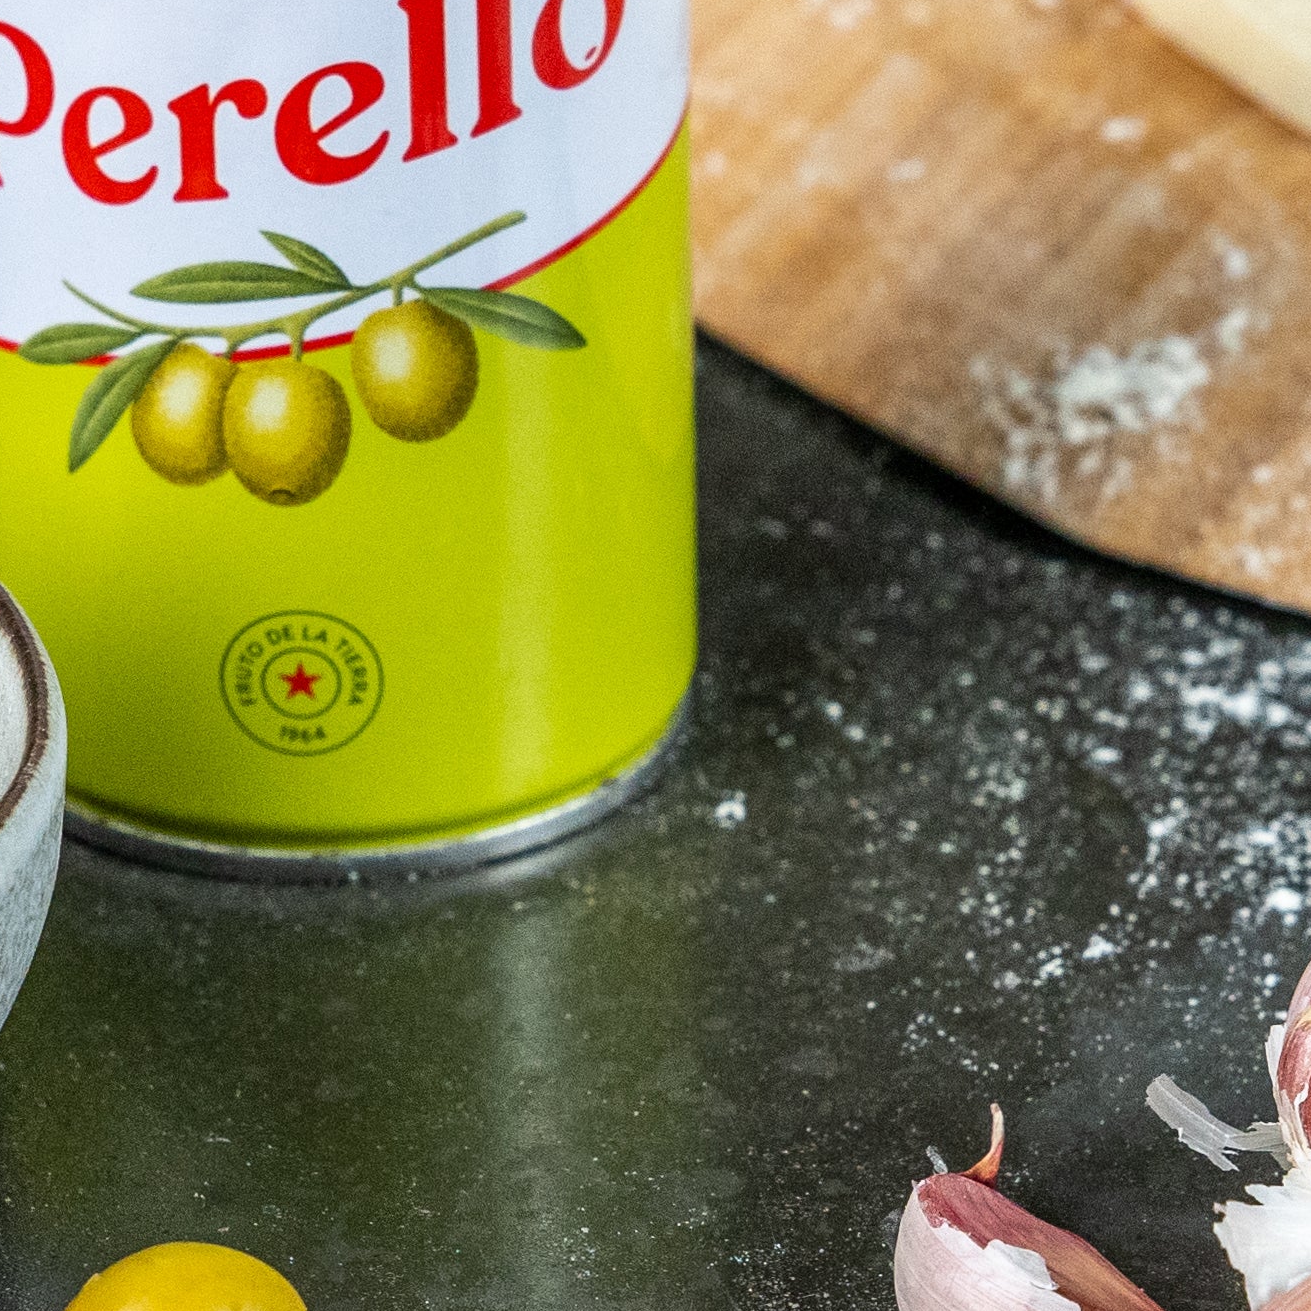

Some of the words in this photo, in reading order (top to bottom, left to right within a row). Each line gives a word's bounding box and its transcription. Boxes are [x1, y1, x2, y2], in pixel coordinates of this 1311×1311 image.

[235, 640, 264, 706] FRUTO
[265, 624, 294, 646] DE
[301, 625, 328, 643] LA
[335, 636, 369, 706] TIERRA
